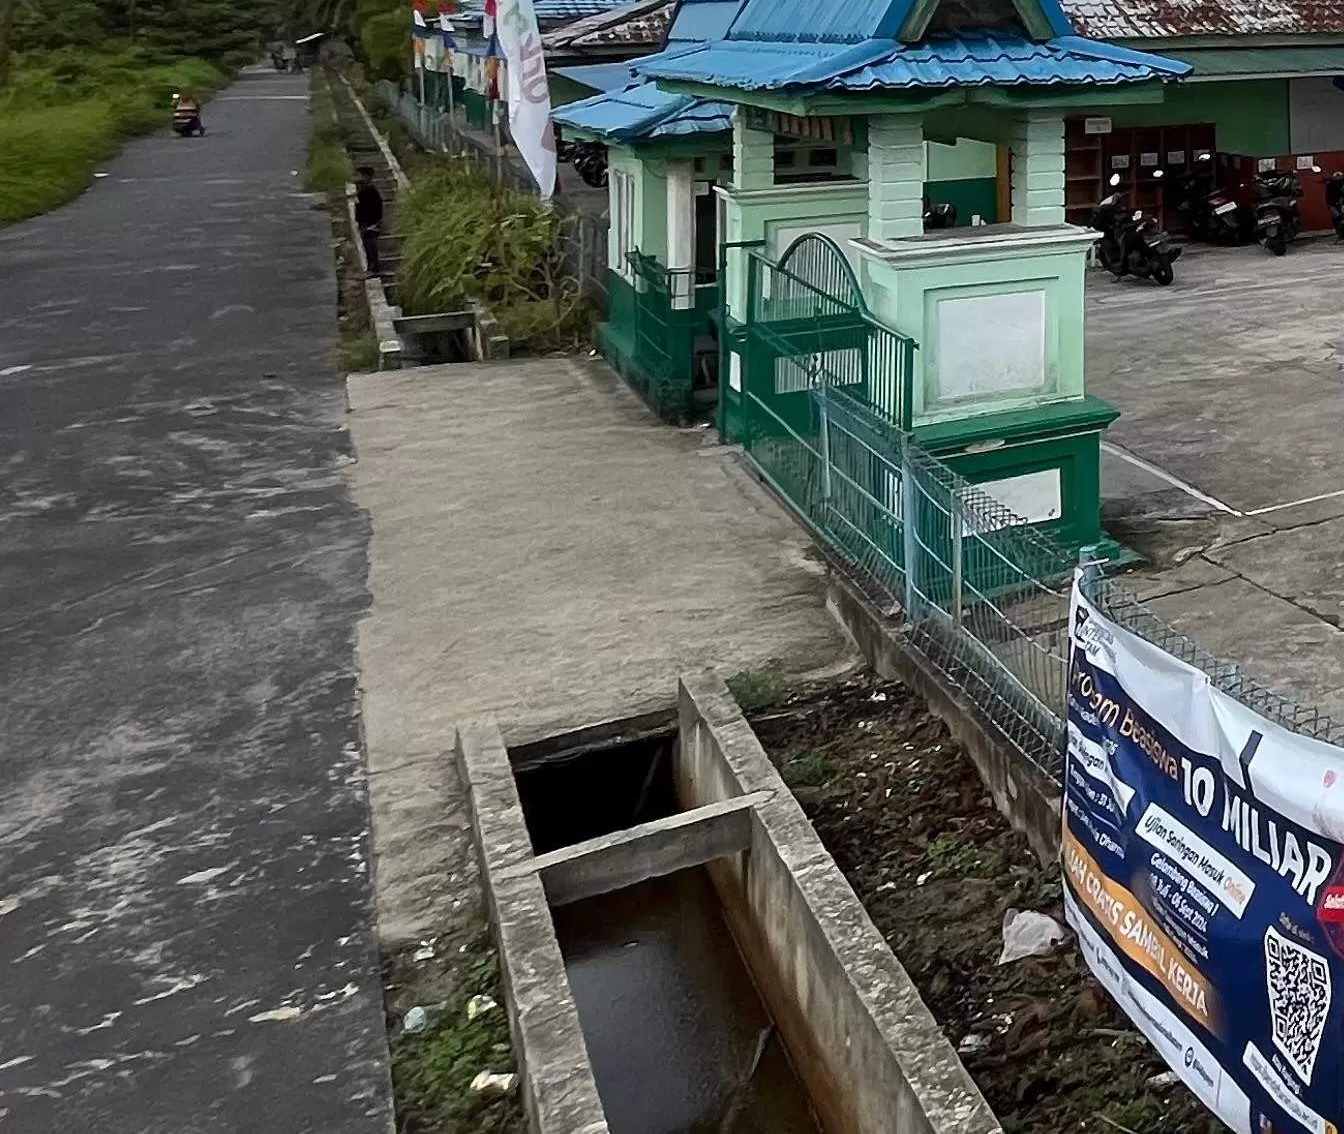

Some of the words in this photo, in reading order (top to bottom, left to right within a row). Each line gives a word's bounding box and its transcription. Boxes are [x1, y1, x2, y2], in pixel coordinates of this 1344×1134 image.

[1144, 814, 1168, 840] Ujian
[1166, 829, 1201, 866] Saringan
[1198, 854, 1225, 885] Masuk
[1180, 756, 1215, 817] 10
[1221, 780, 1332, 906] MILIAR
[1119, 910, 1166, 973] SAMBIL
[1168, 956, 1209, 1017] KERJA
